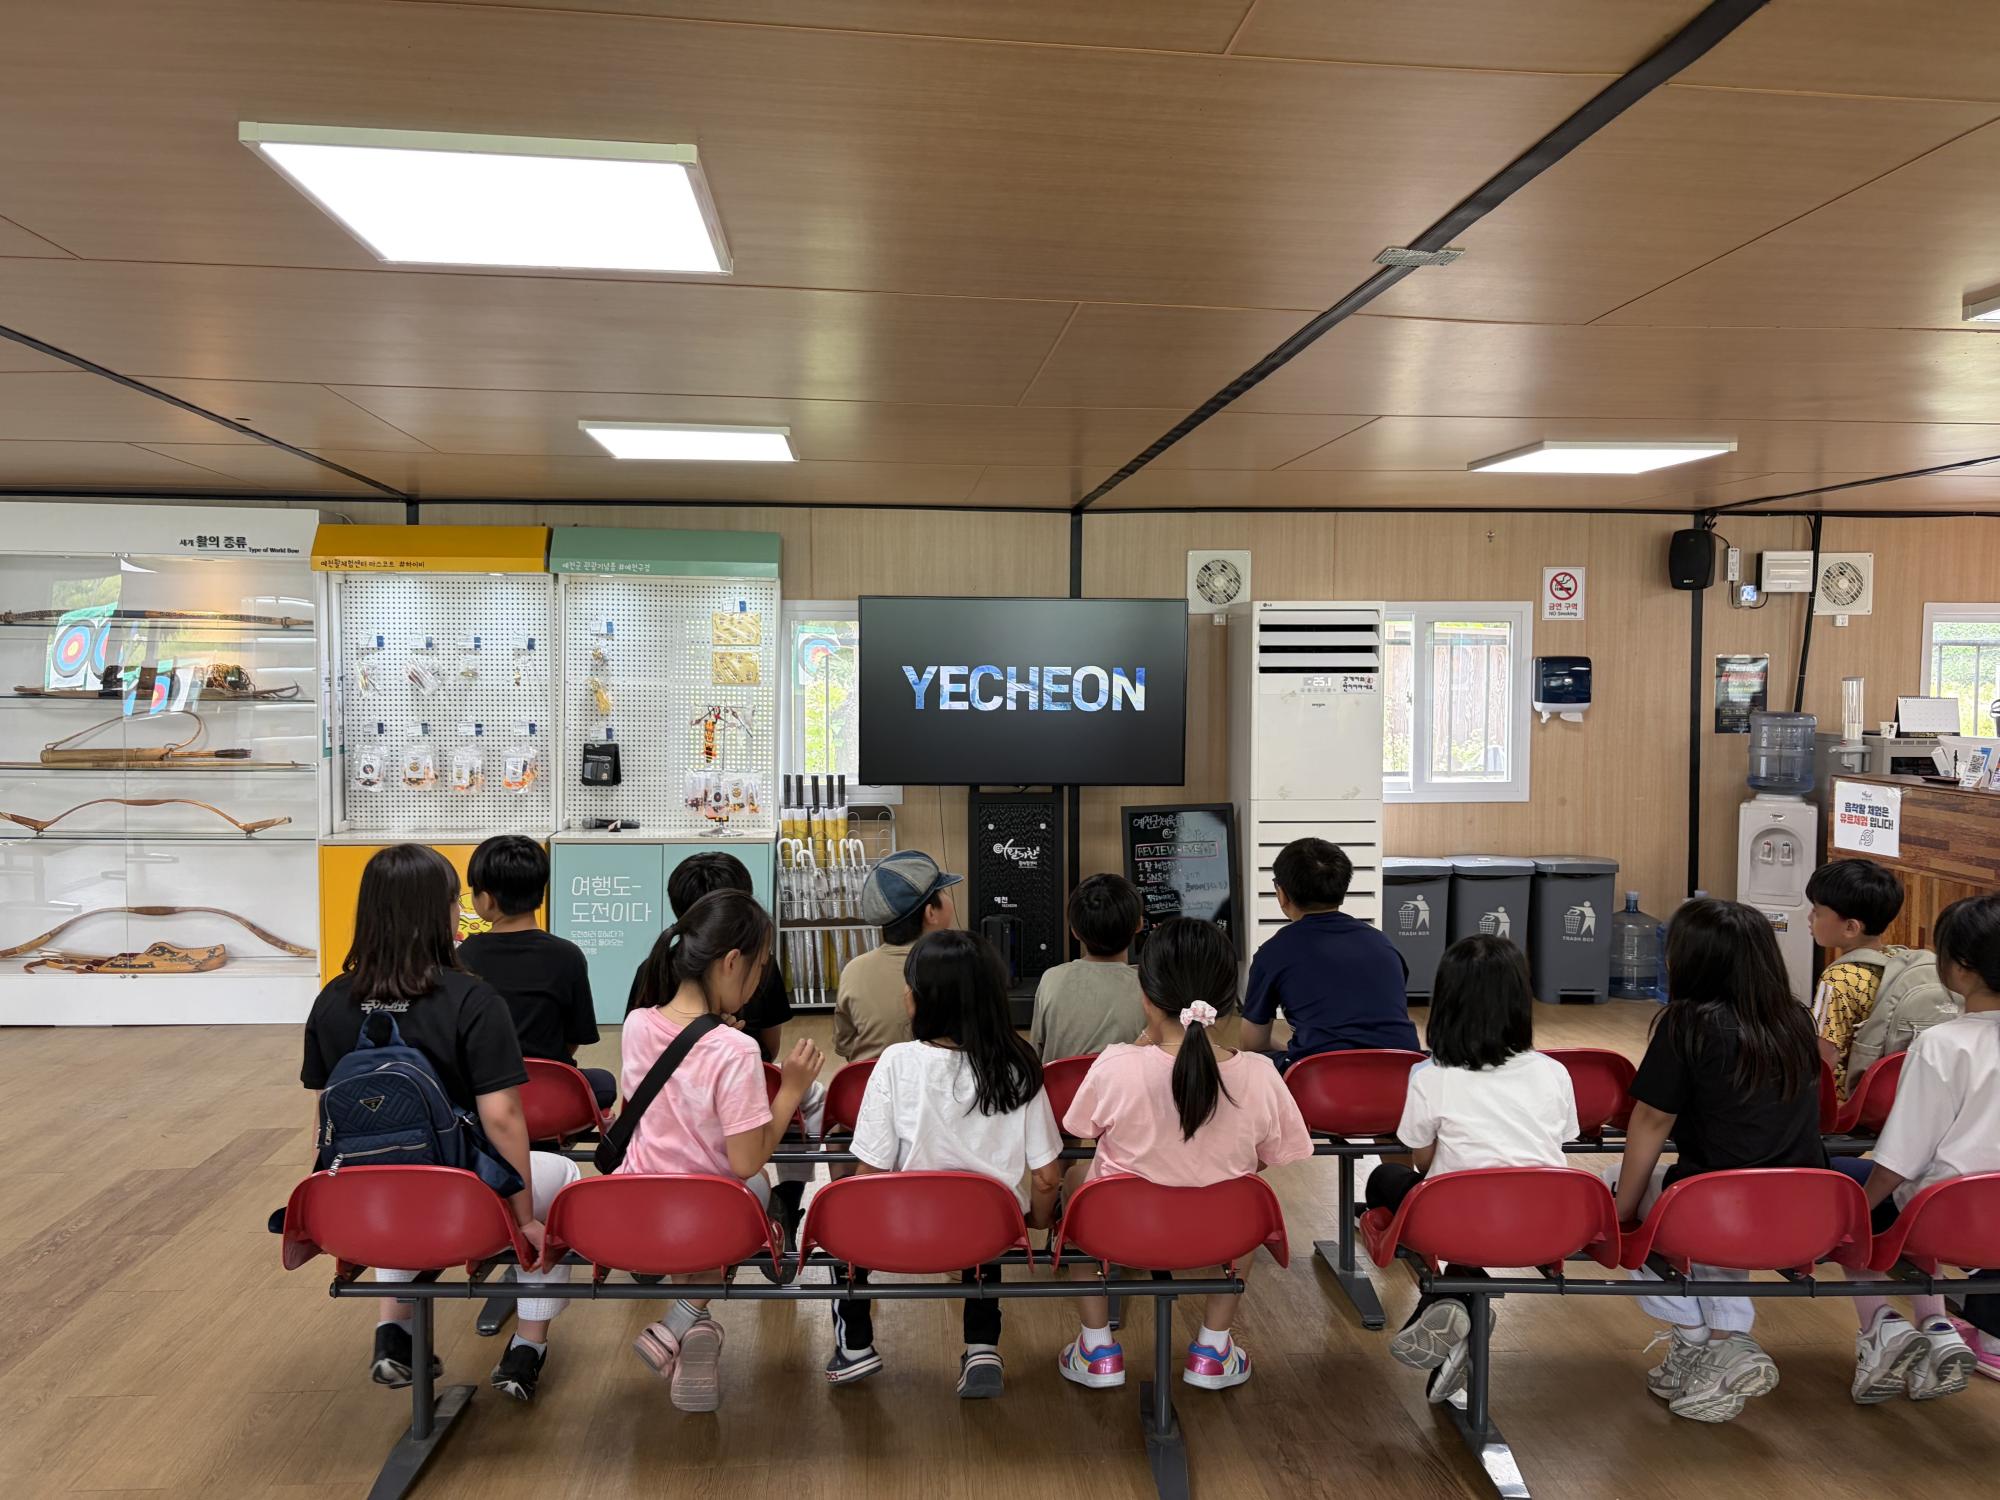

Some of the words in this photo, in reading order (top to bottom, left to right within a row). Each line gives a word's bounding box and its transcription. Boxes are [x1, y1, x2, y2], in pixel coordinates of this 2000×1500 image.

[196, 535, 219, 548] 활의
[223, 536, 247, 548] 종류
[1548, 602, 1562, 611] 금연
[1564, 602, 1578, 611] 구역
[902, 665, 1146, 712] YECHEON
[1867, 804, 1890, 818] 체험은
[1839, 813, 1869, 827] 유료체험
[1869, 817, 1894, 830] 입니다!
[571, 876, 641, 896] 여행도-
[994, 896, 1008, 904] 예천
[571, 902, 652, 922] 도전이다
